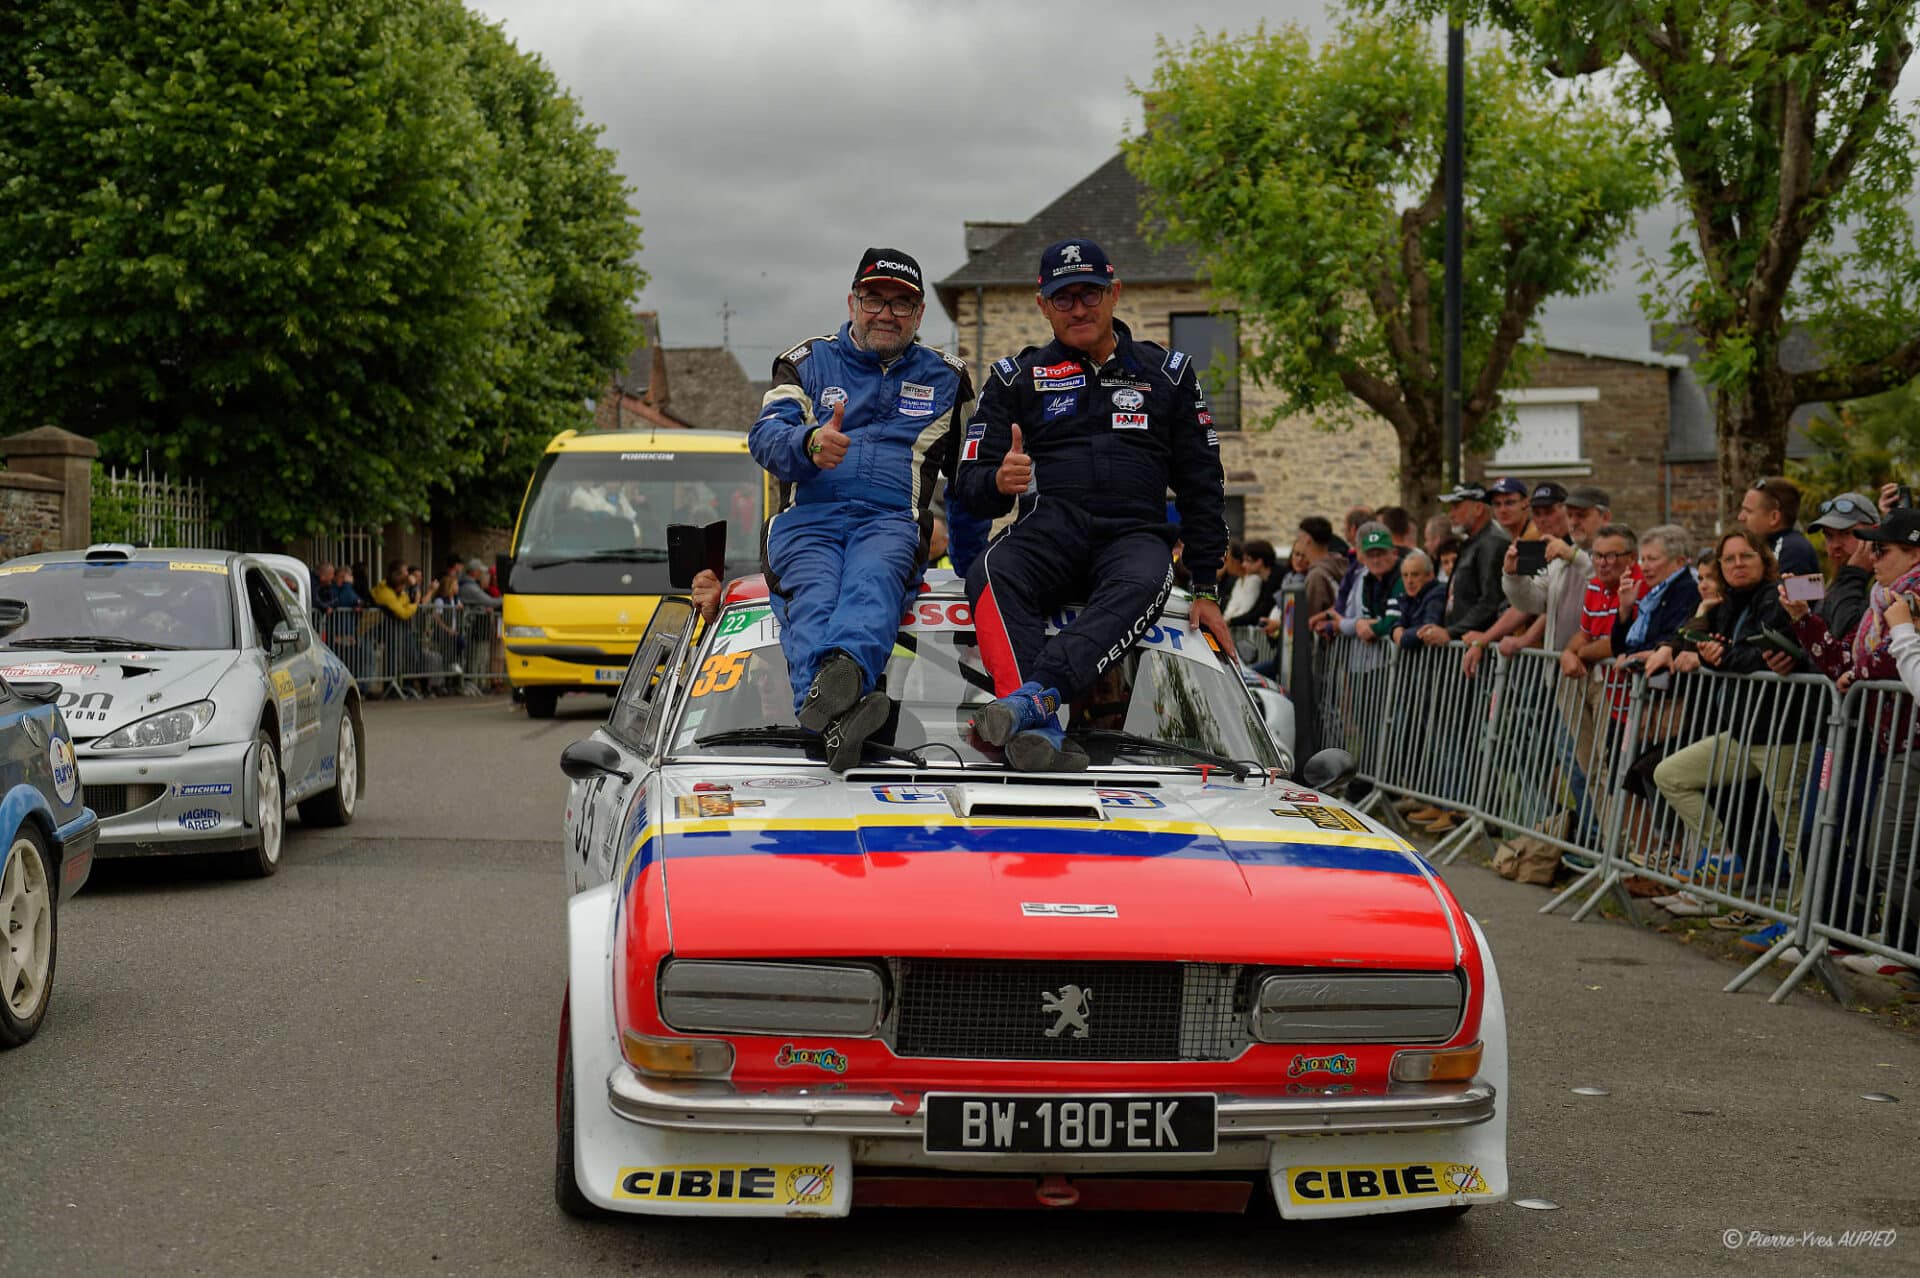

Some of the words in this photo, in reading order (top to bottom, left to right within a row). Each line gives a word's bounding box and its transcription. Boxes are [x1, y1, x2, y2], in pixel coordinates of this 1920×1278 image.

[723, 614, 746, 633] 22
[691, 651, 751, 698] 35
[183, 785, 231, 794] MICHELIN
[962, 1101, 1180, 1147] BW-180-EK
